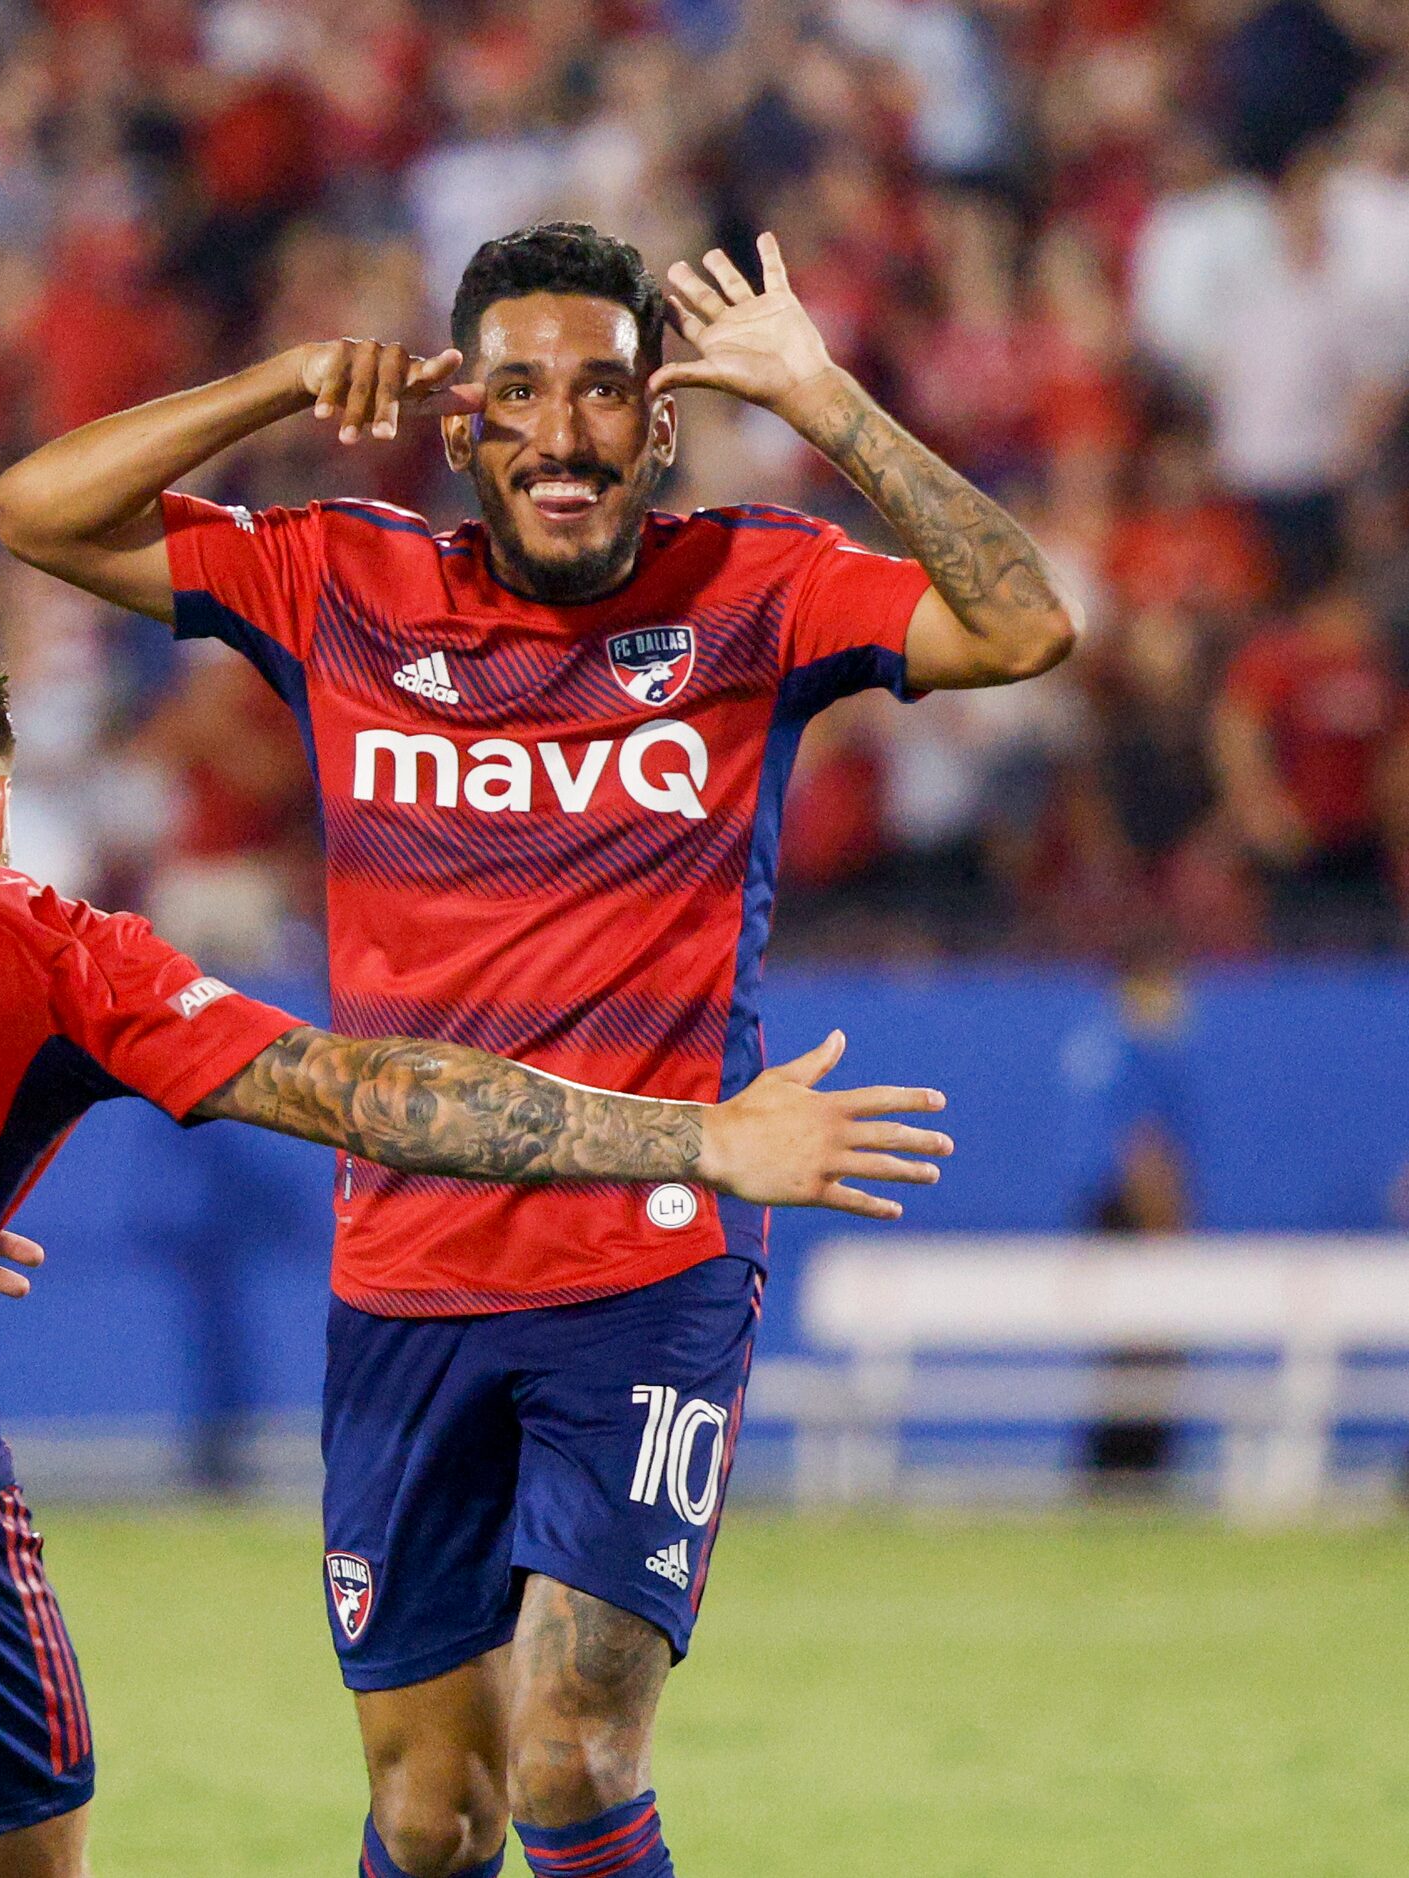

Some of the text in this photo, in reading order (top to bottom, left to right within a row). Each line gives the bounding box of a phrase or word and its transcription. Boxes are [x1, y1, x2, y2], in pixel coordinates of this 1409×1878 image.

[613, 631, 688, 659] FC DALLAS
[393, 671, 460, 705] adidas
[353, 718, 709, 819] mavQ
[659, 1198, 684, 1215] LH
[628, 1384, 728, 1526] 10
